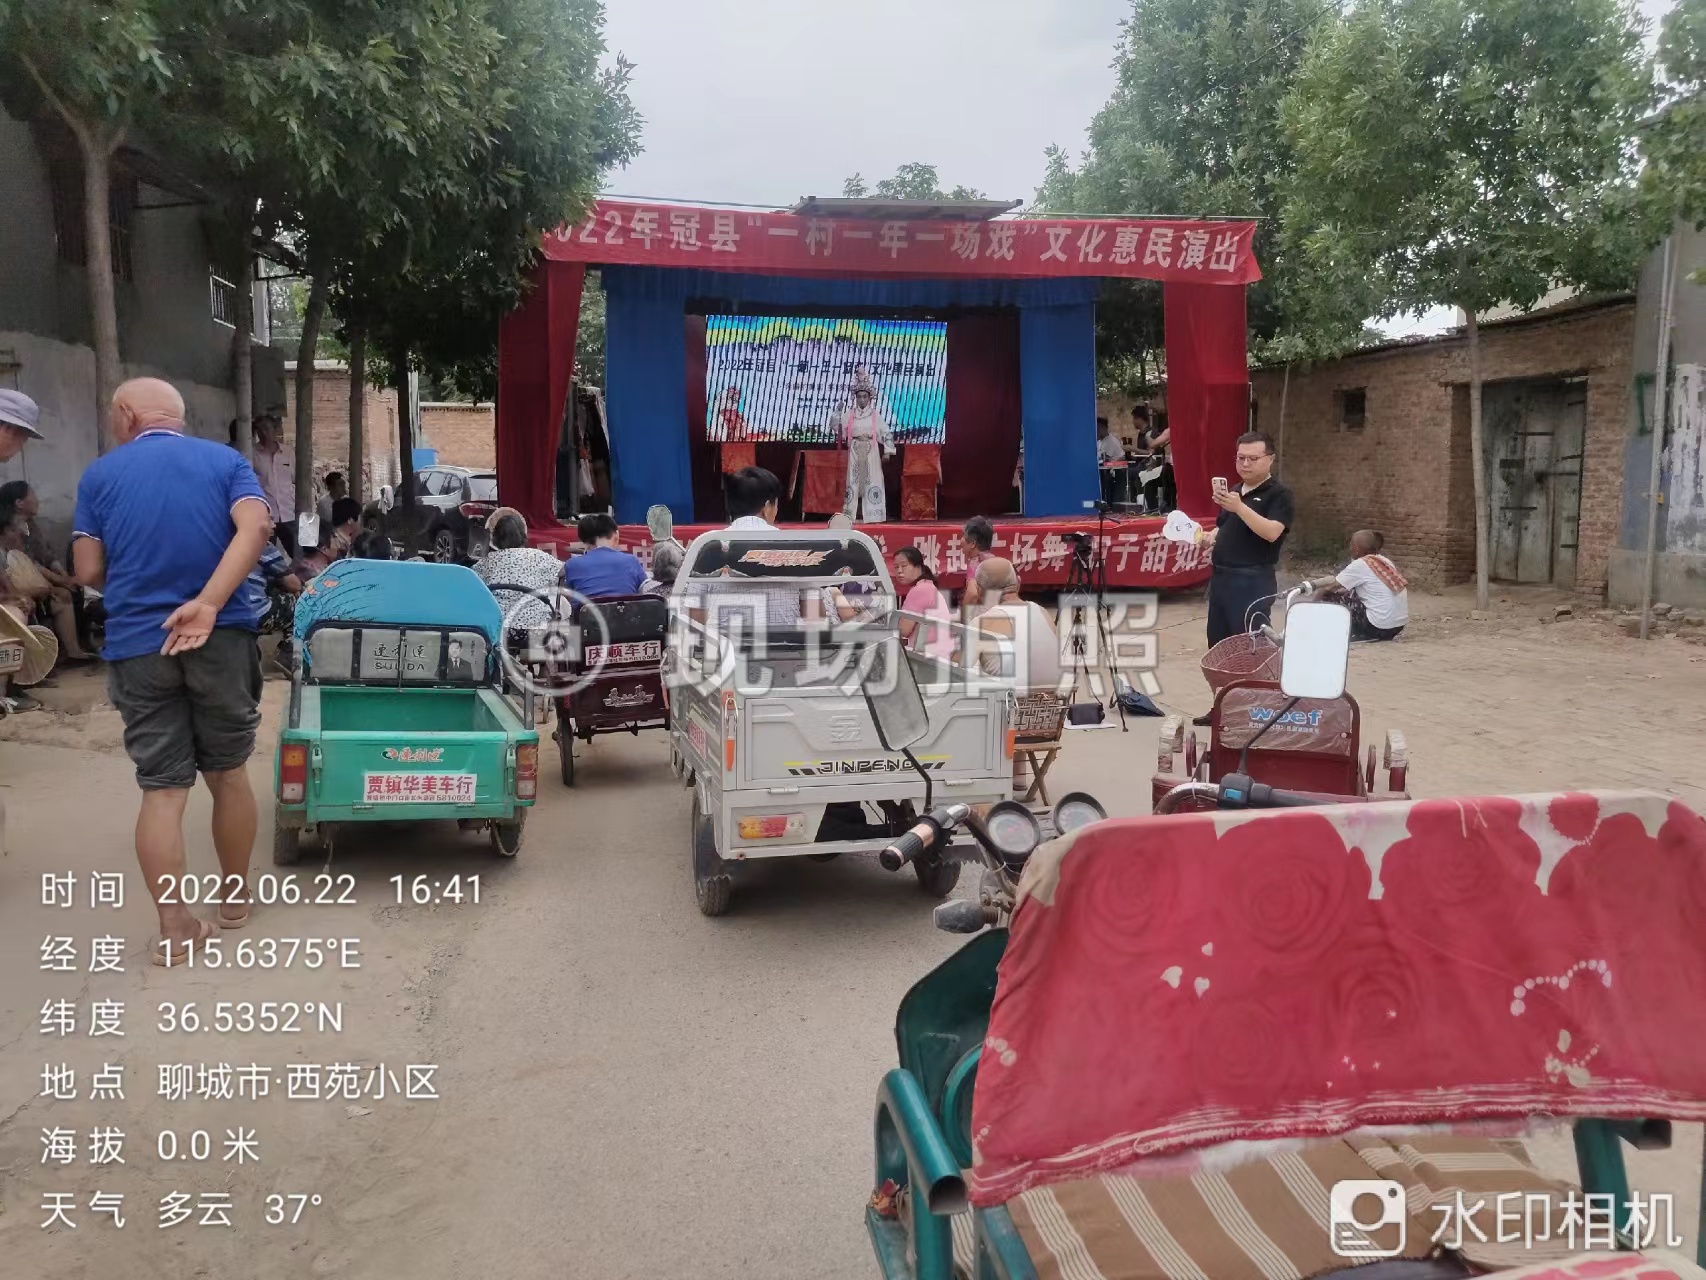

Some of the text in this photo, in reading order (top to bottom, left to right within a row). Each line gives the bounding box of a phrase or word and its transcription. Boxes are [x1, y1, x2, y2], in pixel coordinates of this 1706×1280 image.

[588, 642, 658, 660] 庆顺车行
[367, 775, 473, 794] 贾镇华美车行
